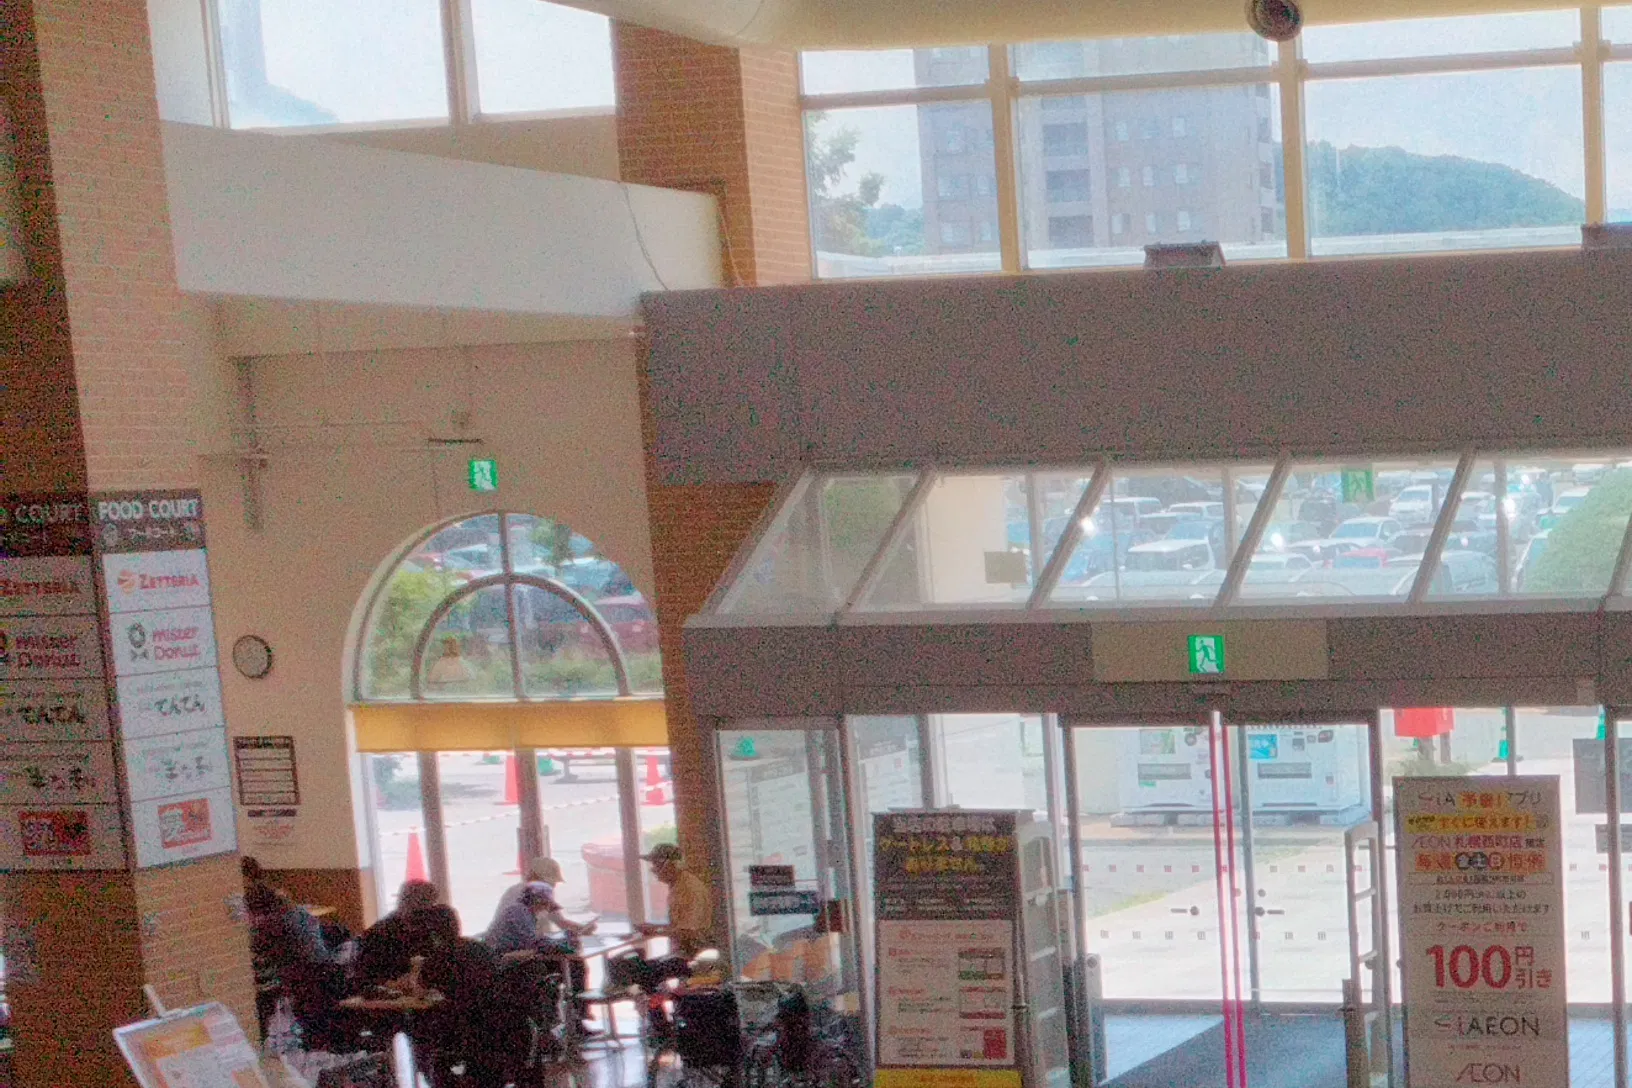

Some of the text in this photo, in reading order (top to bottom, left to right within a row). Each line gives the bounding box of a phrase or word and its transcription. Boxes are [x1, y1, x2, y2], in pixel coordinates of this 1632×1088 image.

[98, 499, 199, 520] FOOD COURT
[1425, 944, 1512, 989] 100
